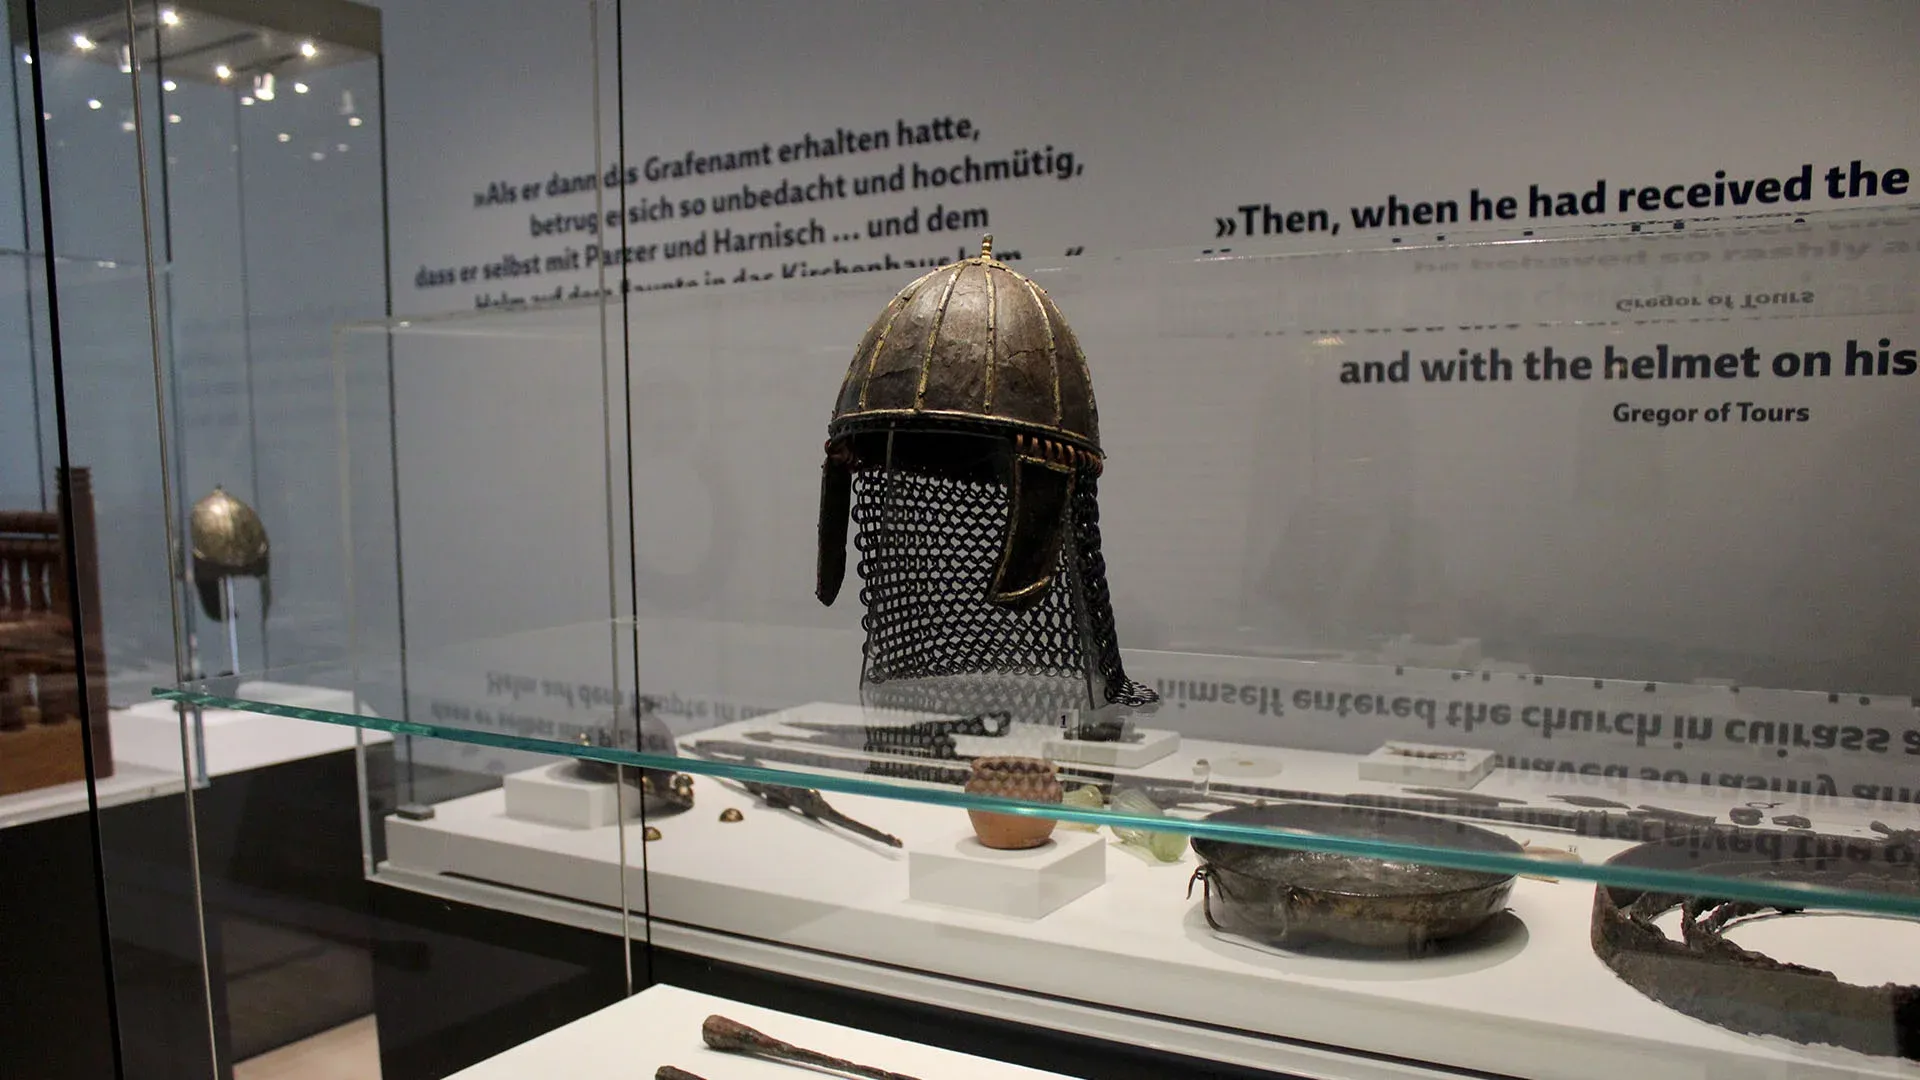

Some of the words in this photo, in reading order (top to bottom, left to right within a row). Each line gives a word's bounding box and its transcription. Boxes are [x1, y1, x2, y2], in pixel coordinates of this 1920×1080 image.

[521, 181, 541, 200] er
[546, 171, 597, 197] dann
[604, 162, 638, 188] ds
[644, 143, 770, 181] Grafenamt
[778, 126, 889, 163] erhalten
[896, 115, 981, 147] hatte,
[530, 211, 598, 238] betrug
[605, 210, 626, 228] e
[628, 194, 674, 223] sich
[679, 199, 706, 218] so
[712, 174, 846, 213] unbedacht
[854, 163, 904, 193] und
[912, 145, 1085, 190] hochmütig,
[1215, 204, 1341, 238] »Then,
[1351, 194, 1458, 228] when
[1470, 188, 1517, 221] he
[1529, 179, 1606, 218] had
[1618, 164, 1812, 213] received
[1825, 160, 1910, 199] the
[415, 265, 455, 289] dass
[460, 265, 478, 282] er
[483, 253, 540, 280] selbst
[546, 246, 579, 271] mit
[664, 232, 707, 260] und
[713, 218, 825, 255] Harnisch
[868, 206, 918, 238] und
[926, 204, 989, 233] dem
[1340, 351, 1410, 384] and
[1420, 347, 1513, 382] with
[1523, 346, 1592, 381] the
[1604, 344, 1760, 379] helmet
[1772, 351, 1831, 378] on
[1845, 338, 1918, 377] his
[1613, 402, 1698, 427] Gregor
[1704, 401, 1731, 422] of
[1737, 402, 1810, 422] Tours
